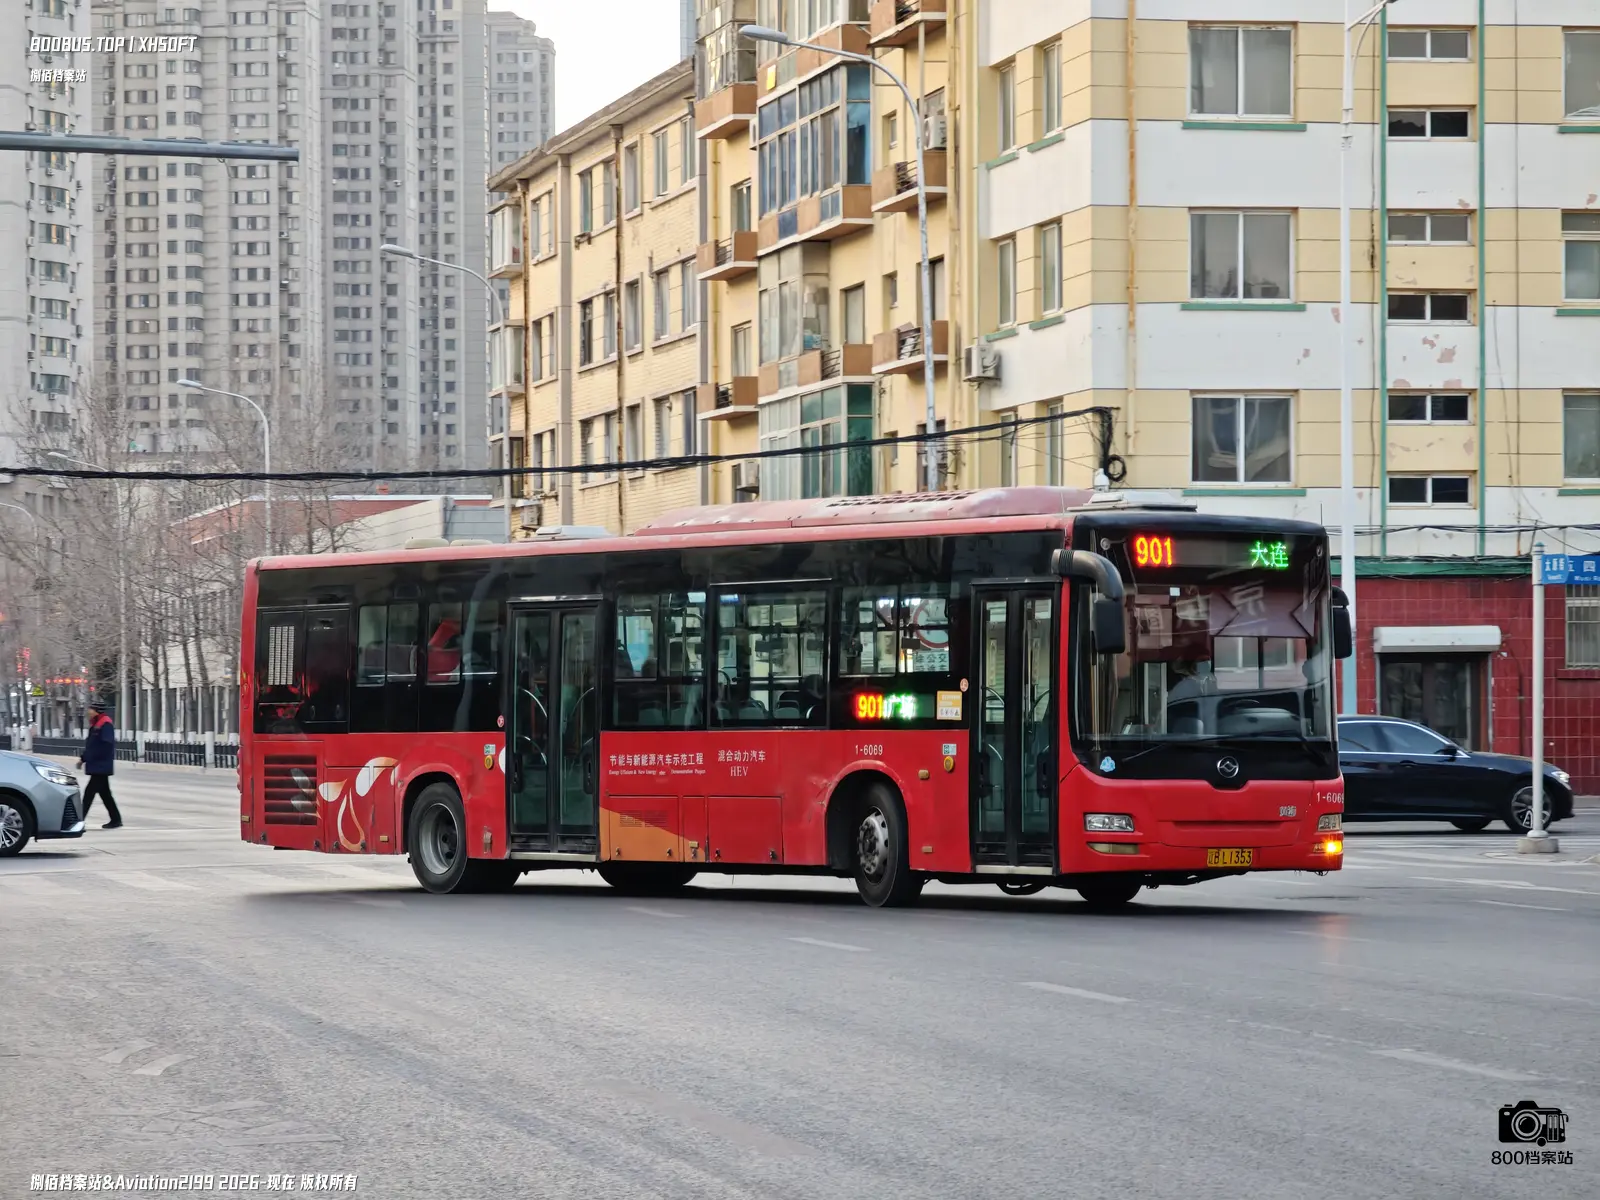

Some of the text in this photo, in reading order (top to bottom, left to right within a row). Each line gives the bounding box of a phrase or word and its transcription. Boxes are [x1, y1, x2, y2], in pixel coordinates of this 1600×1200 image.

[1134, 536, 1289, 568] 901 大连
[718, 749, 766, 763] 混合动力汽车
[855, 744, 883, 756] 1-6069
[609, 752, 704, 767] 节能与新能源汽车示范工程
[730, 766, 749, 777] HEV
